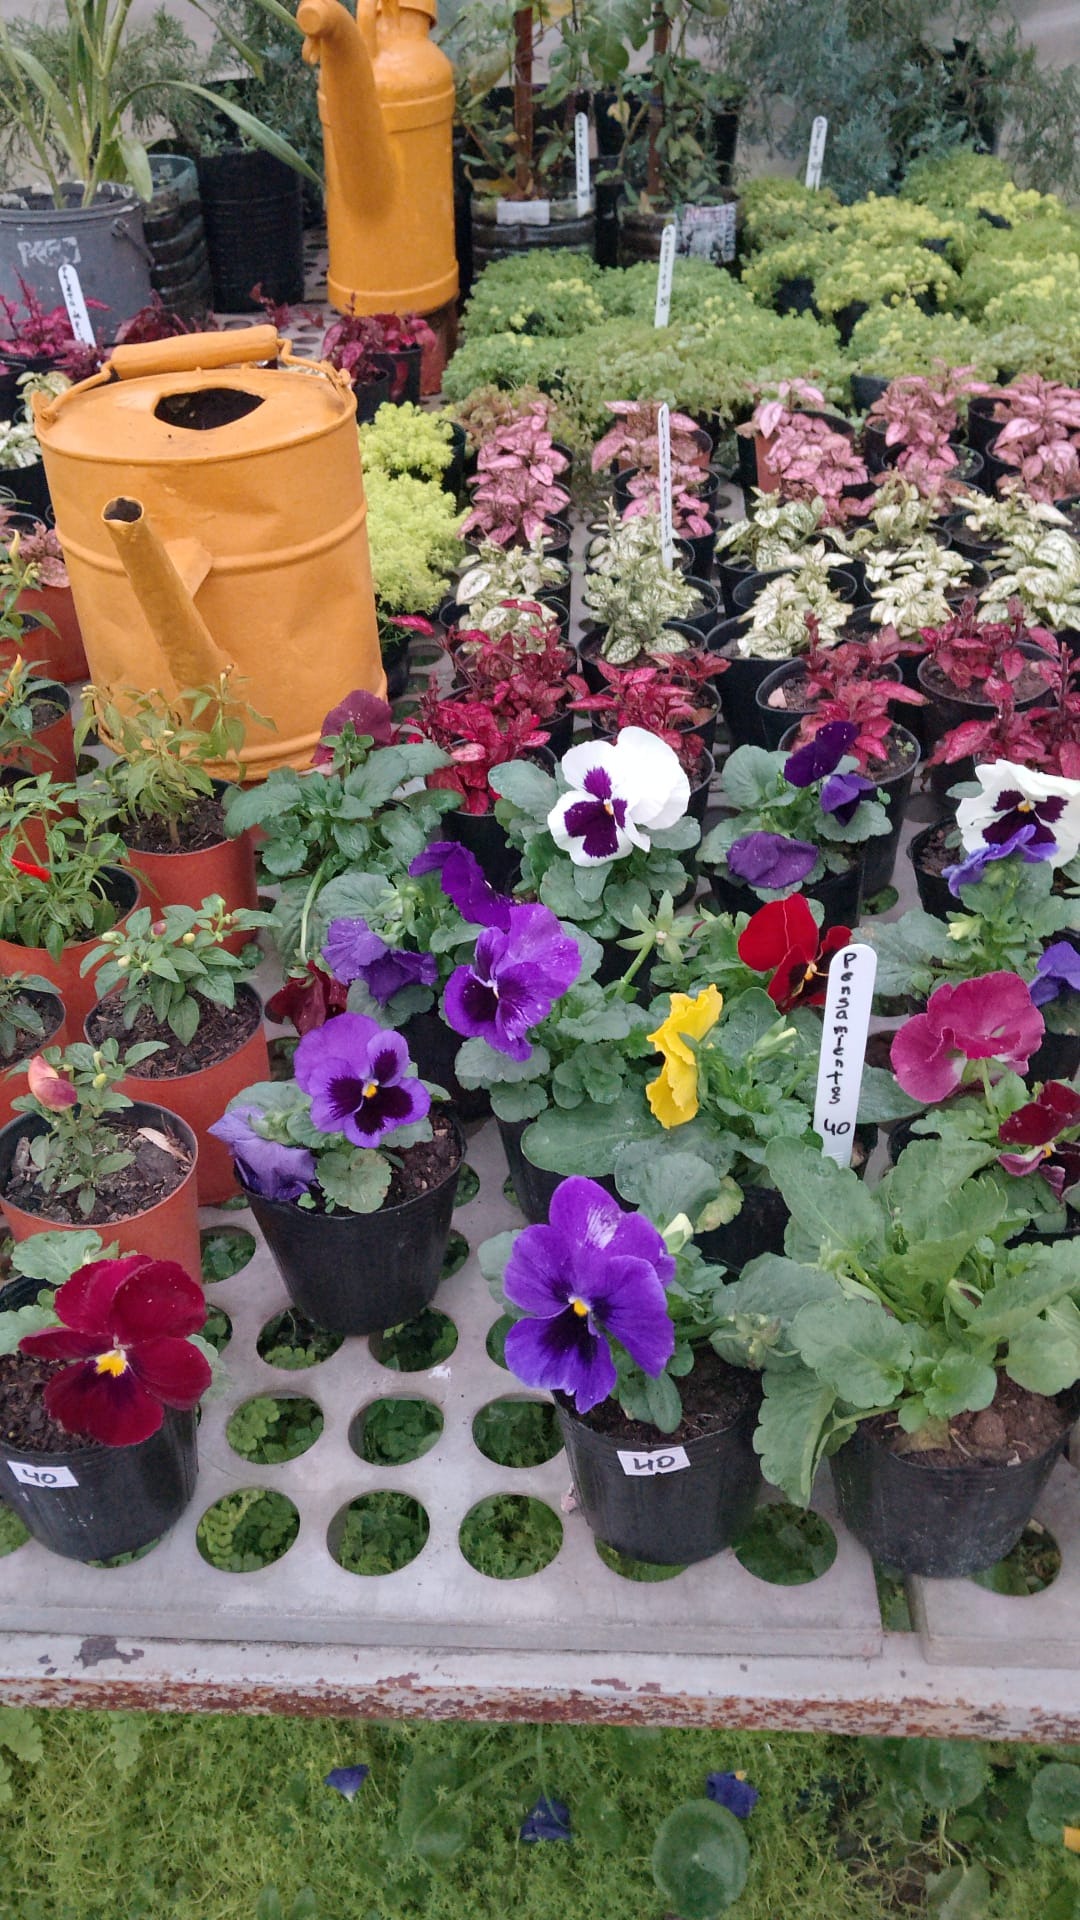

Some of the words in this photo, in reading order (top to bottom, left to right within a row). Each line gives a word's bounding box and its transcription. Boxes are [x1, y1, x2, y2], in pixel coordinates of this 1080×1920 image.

[823, 1117, 851, 1136] 40
[633, 1455, 676, 1471] 40
[22, 1468, 58, 1484] 40
